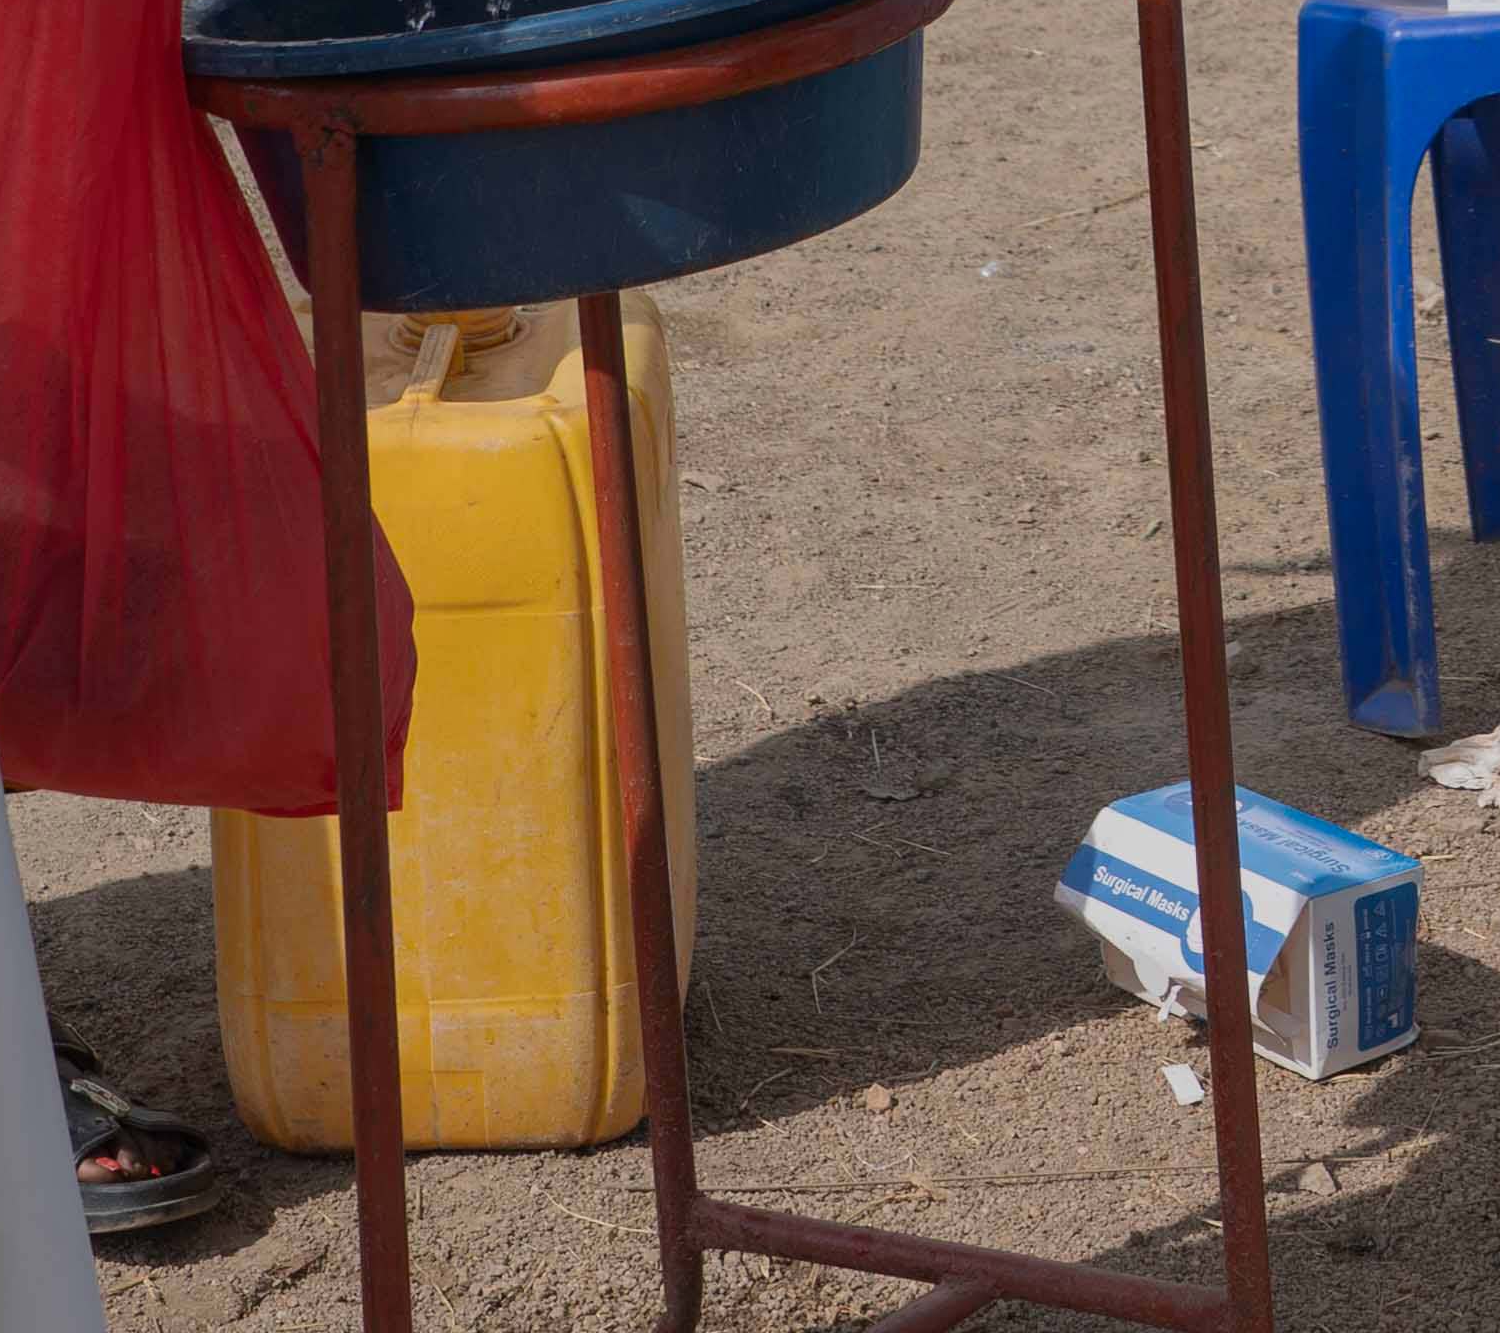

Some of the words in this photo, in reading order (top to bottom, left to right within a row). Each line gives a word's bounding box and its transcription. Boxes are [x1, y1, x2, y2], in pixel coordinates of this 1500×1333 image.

[1276, 839, 1350, 874] Surgical
[1093, 865, 1149, 902] Surgical
[1146, 889, 1190, 922] Masks
[1324, 922, 1336, 976] Masks
[1325, 980, 1340, 1049] Surgical
